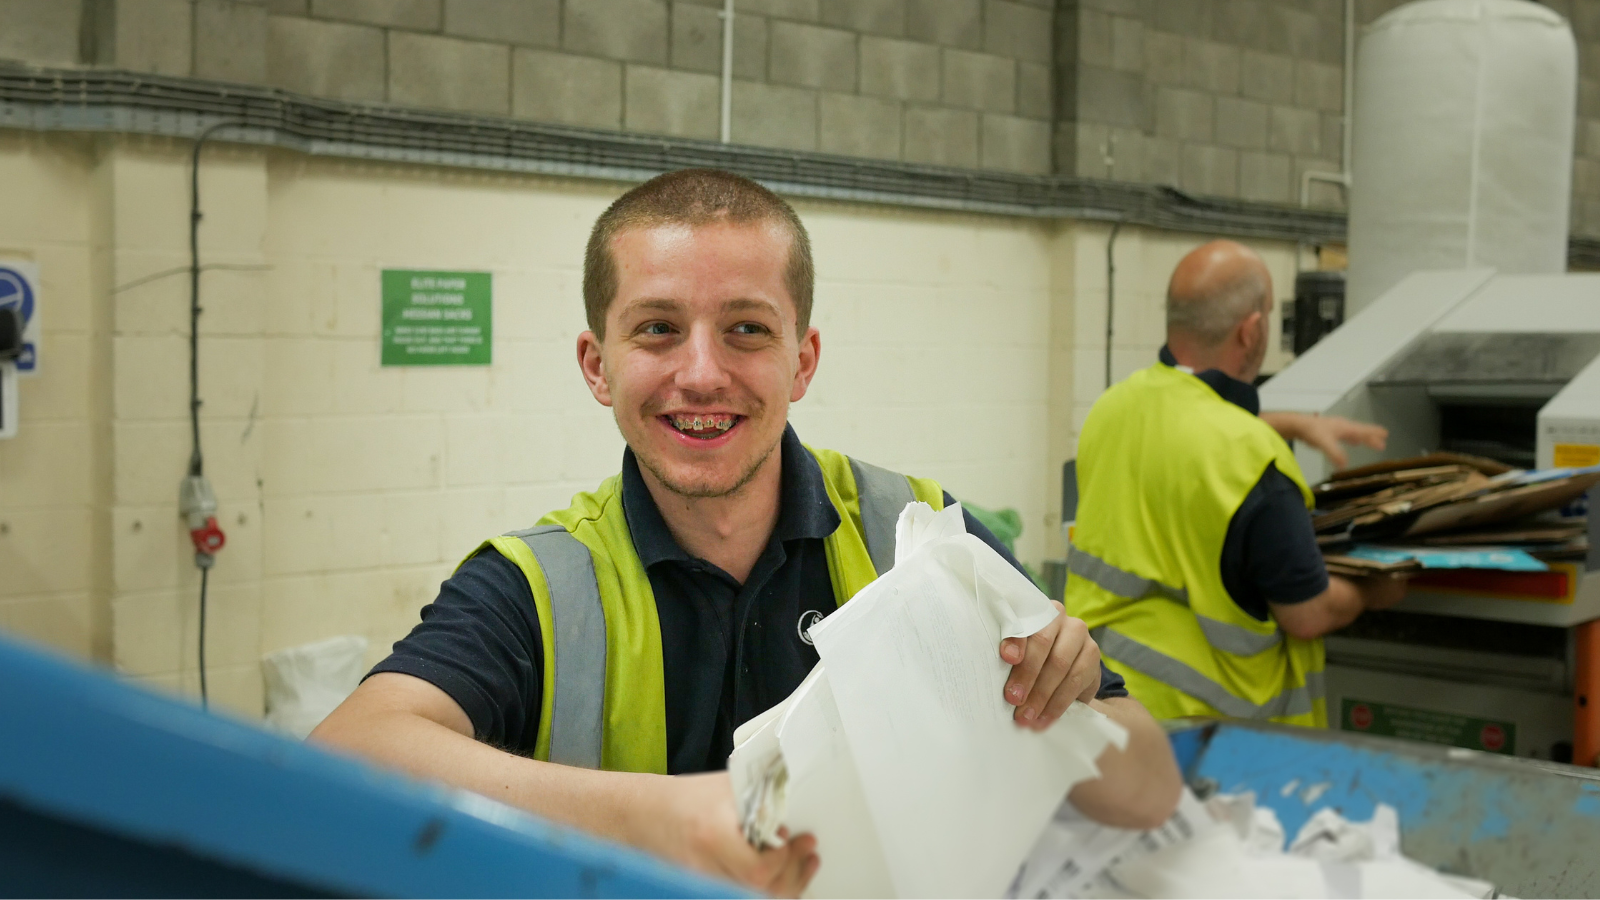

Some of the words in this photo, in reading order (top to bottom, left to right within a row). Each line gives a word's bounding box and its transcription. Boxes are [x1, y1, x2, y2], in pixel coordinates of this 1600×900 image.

[411, 277, 435, 290] ELITE
[437, 278, 466, 290] PAPER
[411, 293, 464, 305] SOLUTIONS
